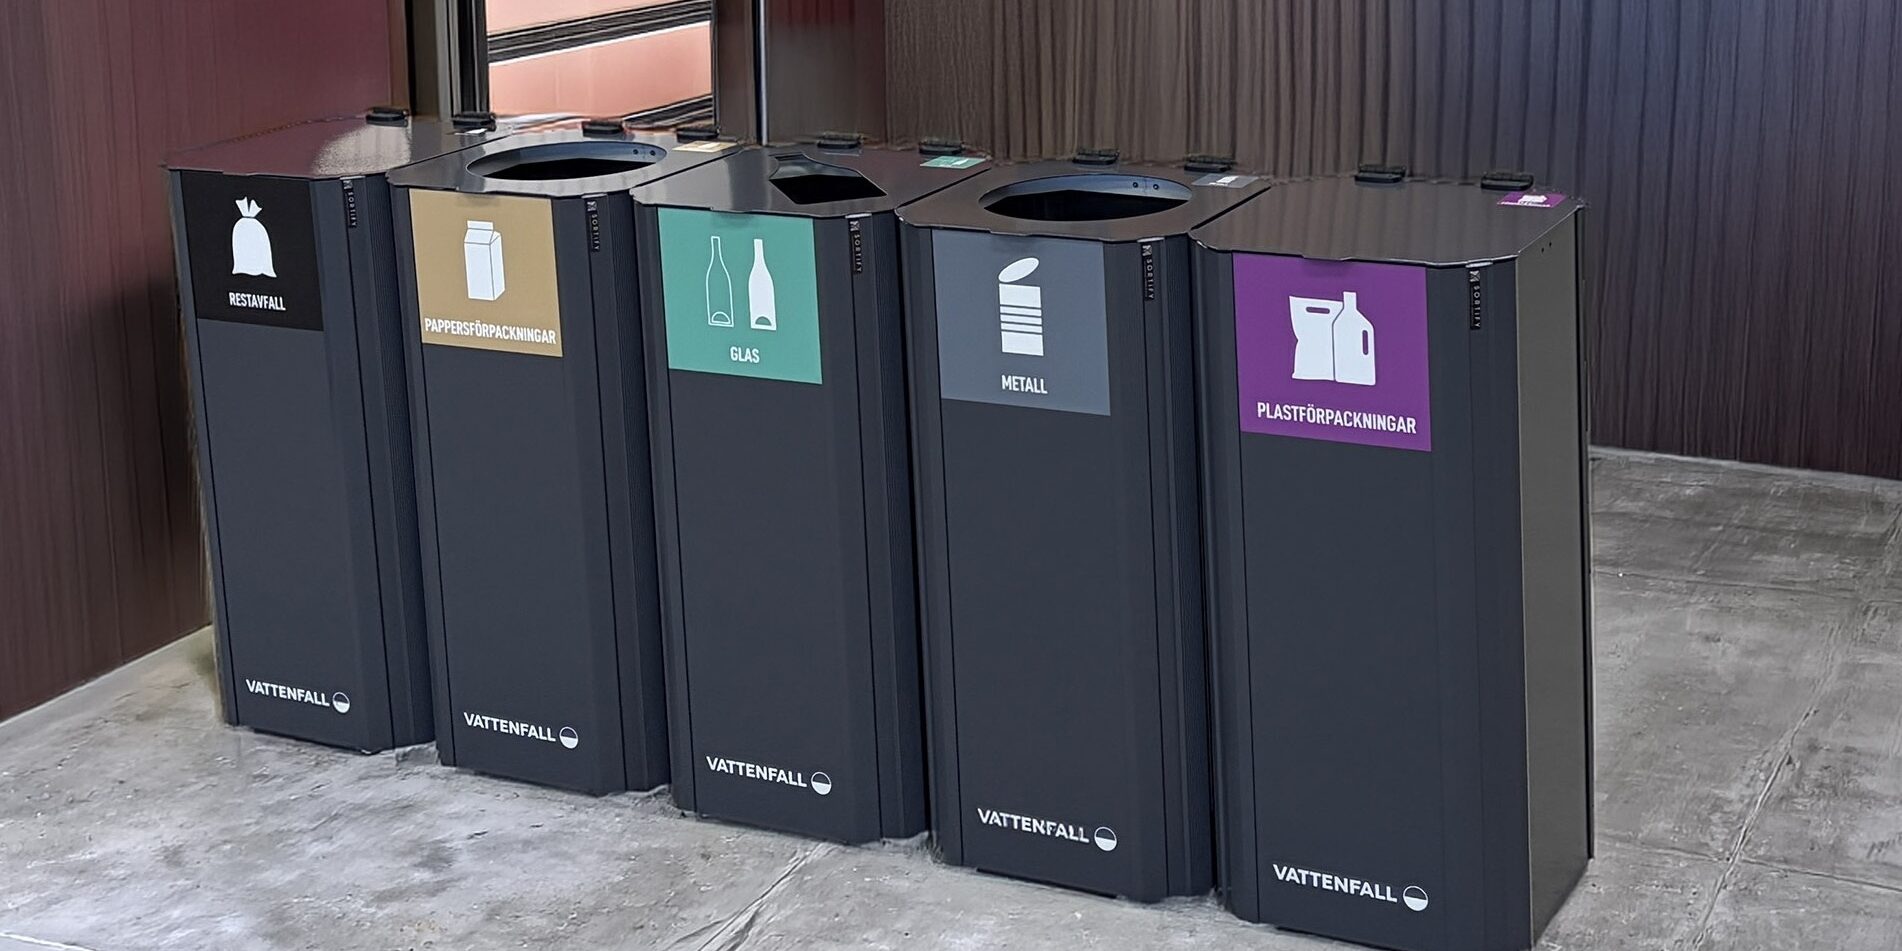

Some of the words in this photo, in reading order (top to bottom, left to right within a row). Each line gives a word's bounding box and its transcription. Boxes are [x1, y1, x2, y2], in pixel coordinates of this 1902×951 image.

[228, 292, 286, 311] RESTAVFALL
[424, 317, 557, 345] PAPPERSFÖRPACKNINGAR
[730, 346, 760, 364] GLAS
[1001, 374, 1048, 394] METALL
[1257, 402, 1417, 434] PLASTFÖRPACKNINGAR
[246, 679, 330, 707] VATTENFALL
[463, 711, 556, 742] VATTENFALL
[706, 755, 807, 788] VATTENFALL
[977, 807, 1090, 843] VATTENFALL
[1272, 863, 1398, 903] VATTENFALL
